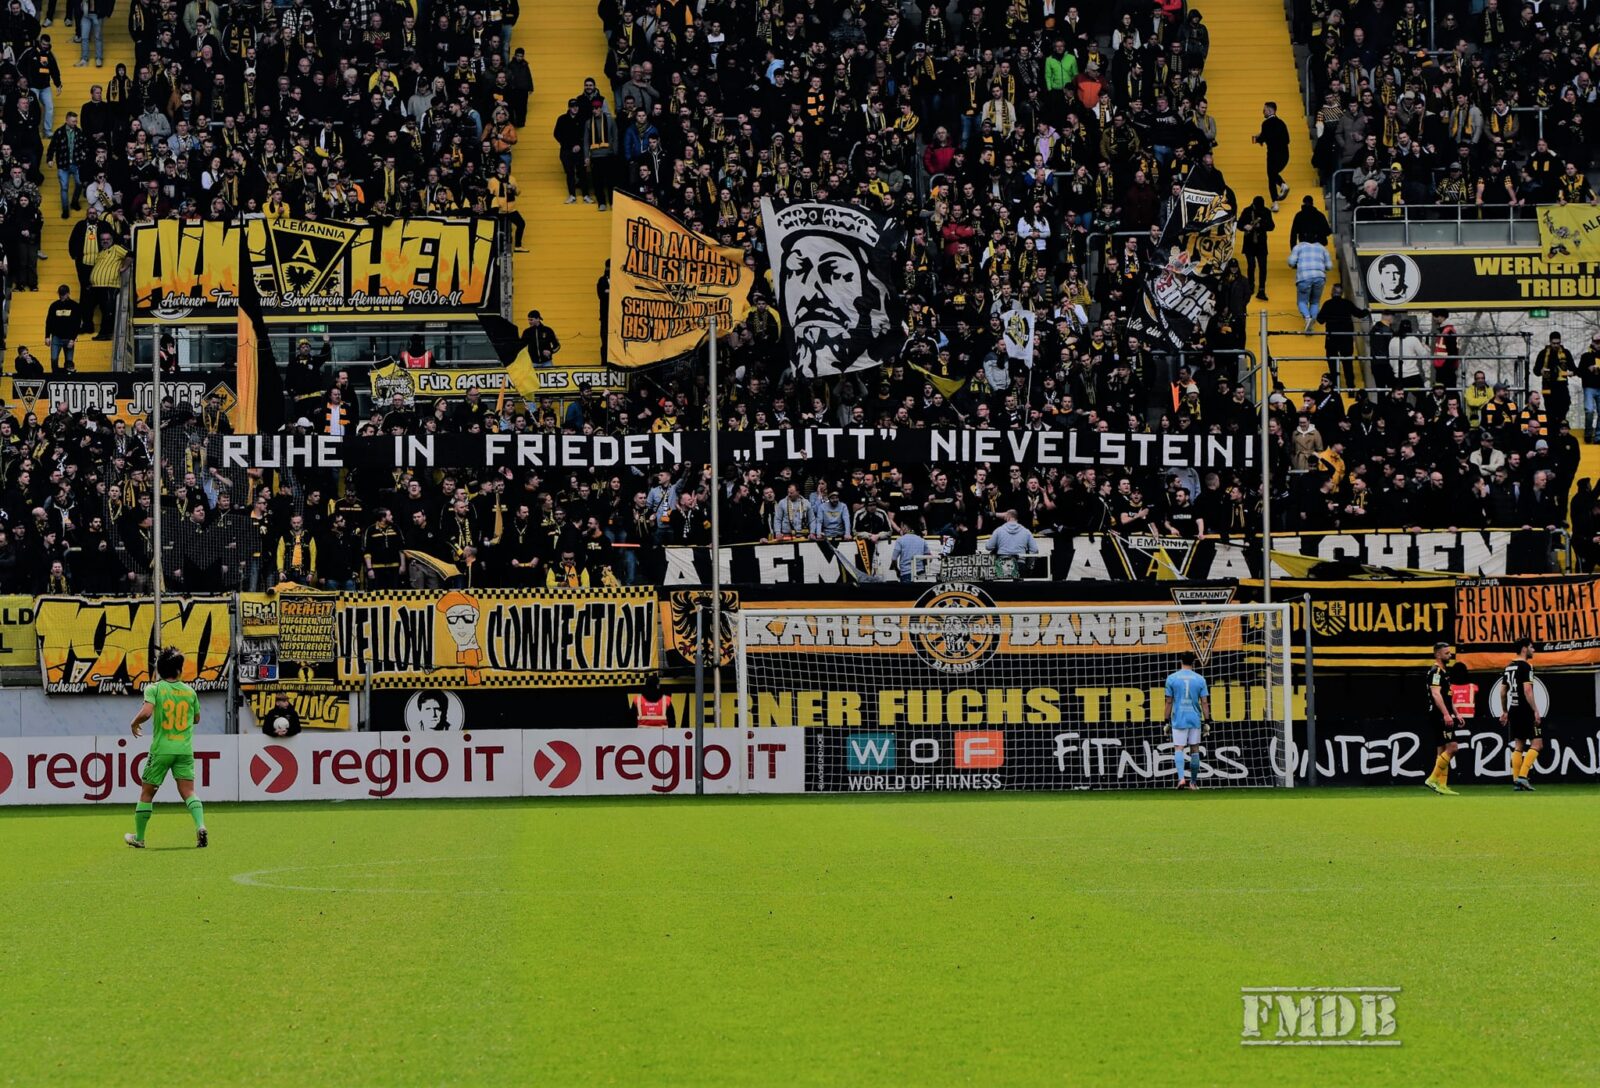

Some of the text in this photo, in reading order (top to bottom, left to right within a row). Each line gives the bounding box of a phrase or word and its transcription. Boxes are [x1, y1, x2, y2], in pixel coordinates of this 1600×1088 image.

[273, 218, 346, 240] ALEMANNIA
[626, 217, 662, 256] FÜR
[625, 247, 739, 287] ALLES GEBEN
[1474, 256, 1580, 276] WERNER
[161, 291, 207, 308] Aachener
[280, 291, 344, 311] Sportverein
[347, 290, 404, 307] Alemannia
[407, 290, 438, 305] 1900
[623, 297, 679, 318] SCHWARZ
[622, 315, 649, 339] BIS
[653, 319, 670, 340] IN
[419, 371, 451, 390] FÜR
[572, 371, 626, 388] GEBEN!
[223, 435, 344, 468] RUHE
[395, 435, 435, 467] IN
[486, 432, 683, 466] FRIEDEN
[931, 429, 1254, 468] NIEVELSTEIN!
[941, 555, 996, 568] LEGENDEN
[941, 566, 979, 578] STERBEN
[933, 583, 981, 597] KARLS
[1178, 591, 1230, 600] ALEMANNIA
[1456, 582, 1595, 614] FREUNDSCHAFT
[0, 608, 34, 625] LD
[243, 602, 277, 616] 50+1
[281, 601, 333, 615] FREIHEIT
[1349, 602, 1449, 632] WACHT
[281, 625, 333, 633] SICHERHEIT
[746, 612, 1168, 646] KARLS BANDE
[1456, 609, 1600, 643] ZUSAMMENHALT
[339, 602, 653, 675] YELLOW CONNECTION
[240, 665, 257, 678] ZU
[933, 660, 981, 673] BANDE
[1183, 679, 1191, 700] 1
[161, 699, 189, 731] 30
[878, 687, 1062, 726] FUCHS
[596, 731, 732, 793] regio
[1053, 732, 1249, 779] FITNESS
[1270, 731, 1426, 779] UNTER
[313, 735, 449, 797] regio
[848, 774, 1002, 791] WORLD OF FITNESS
